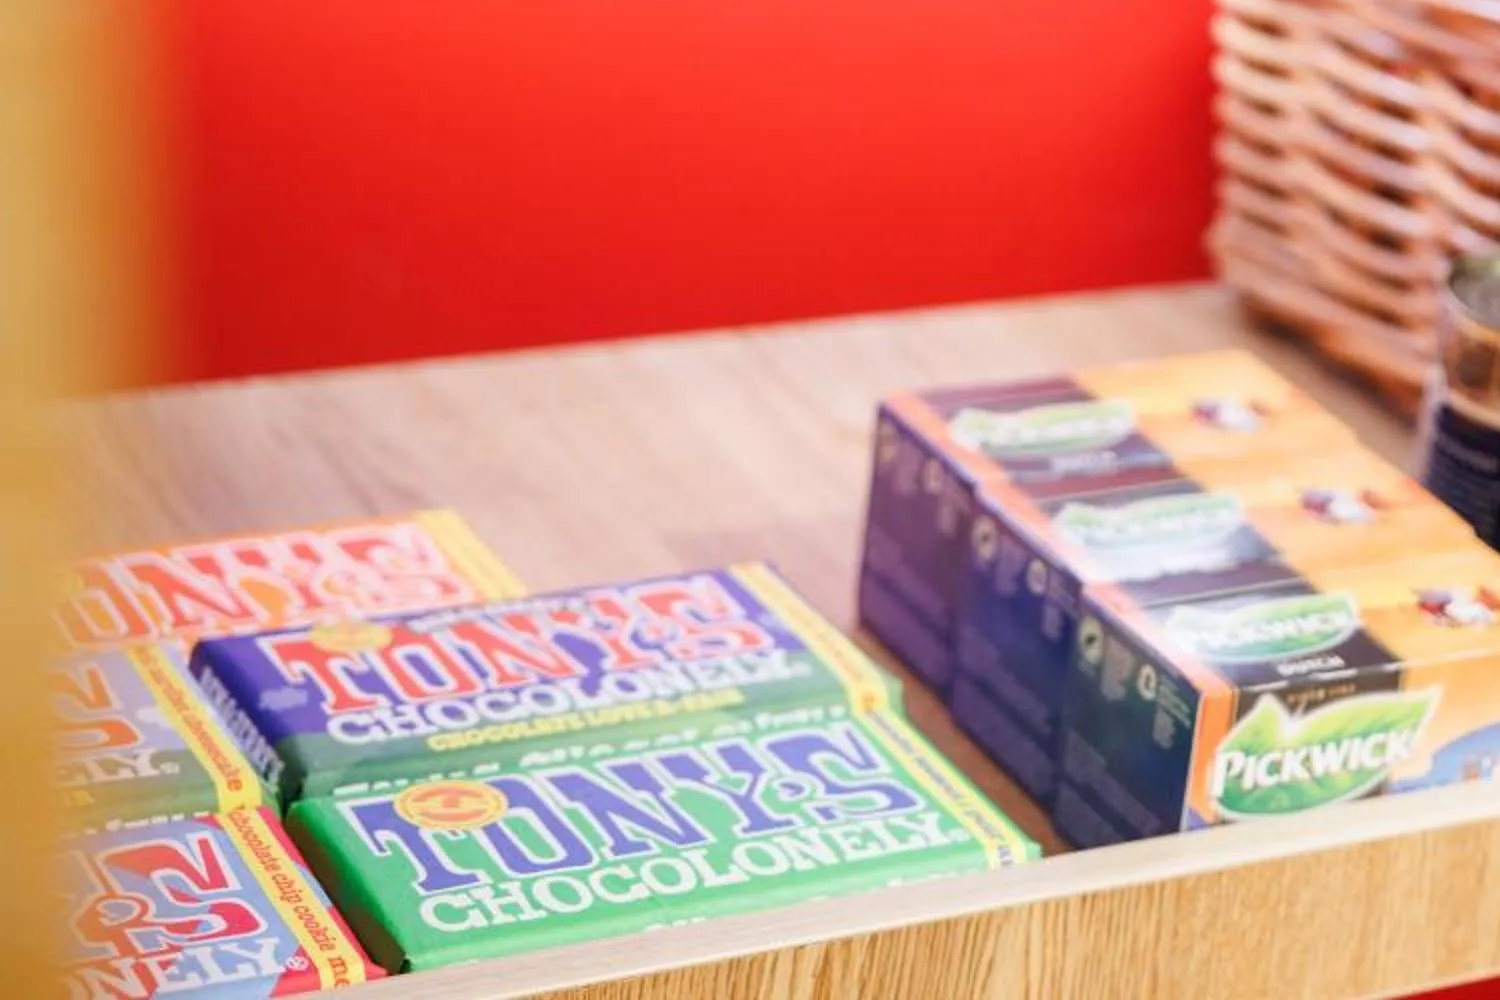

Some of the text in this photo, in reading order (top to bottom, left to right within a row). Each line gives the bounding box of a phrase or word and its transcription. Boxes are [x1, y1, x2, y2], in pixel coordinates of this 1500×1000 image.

[335, 718, 930, 896] TONY'S
[1211, 726, 1413, 798] PICKWICK
[420, 811, 953, 933] CHOCOLONELY
